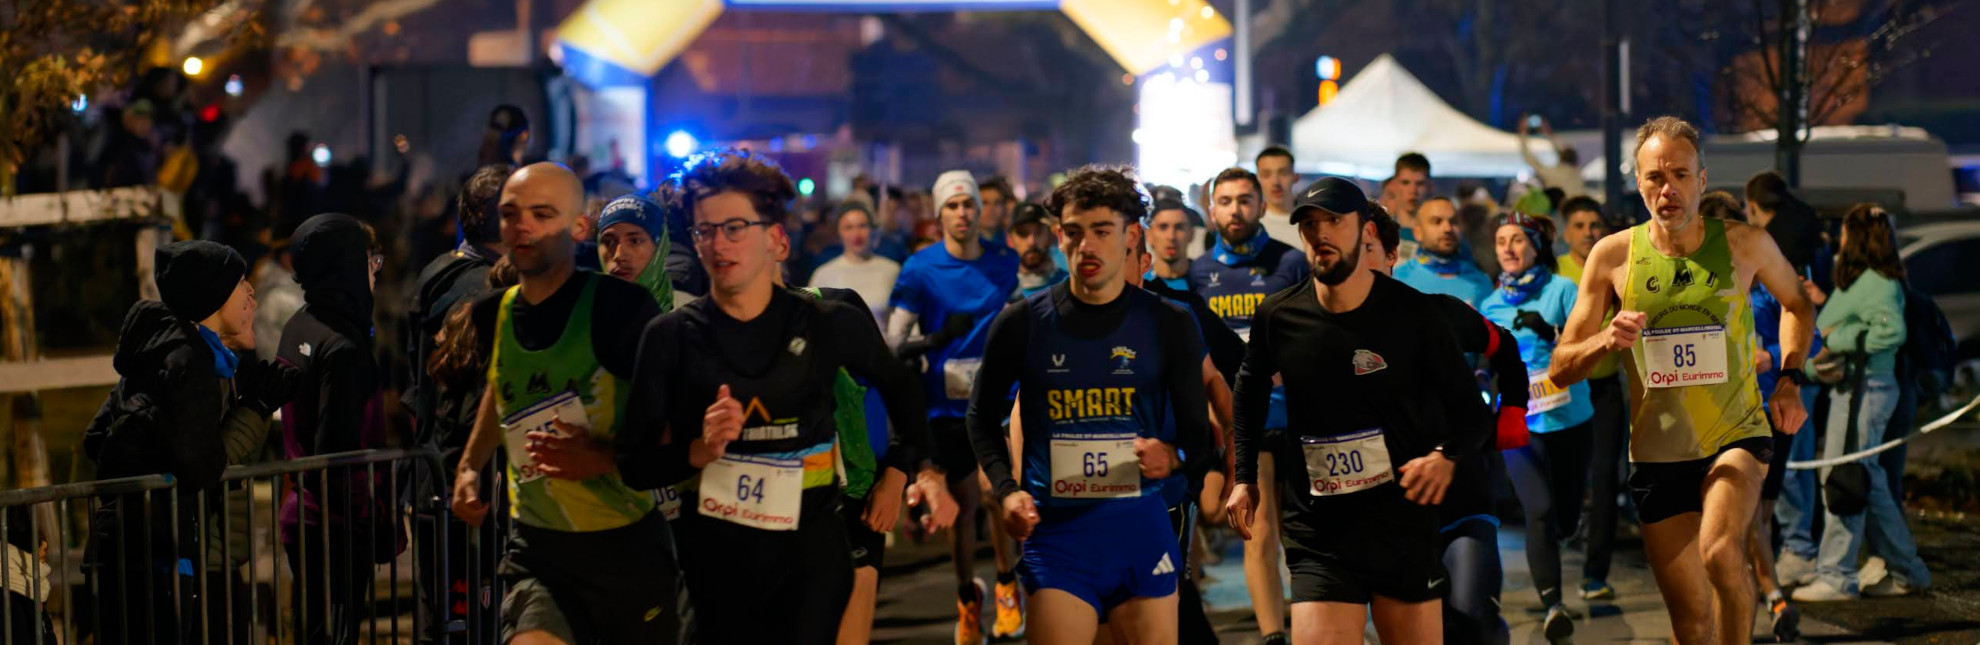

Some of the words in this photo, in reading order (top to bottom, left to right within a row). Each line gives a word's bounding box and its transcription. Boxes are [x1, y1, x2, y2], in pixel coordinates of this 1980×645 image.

[1673, 343, 1696, 368] 85
[1651, 369, 1679, 386] Orpi
[1682, 371, 1724, 382] Eurimmo
[1047, 387, 1136, 420] SMART
[1083, 452, 1108, 478] 65
[1326, 449, 1364, 477] 230
[737, 474, 765, 504] 64
[1055, 479, 1087, 496] Orpi
[1090, 483, 1137, 493] Eurimmo
[1313, 478, 1342, 494] Orpi
[1345, 472, 1389, 488] Eurimmo
[703, 497, 738, 517] Orpi
[741, 508, 794, 524] Eurimmo
